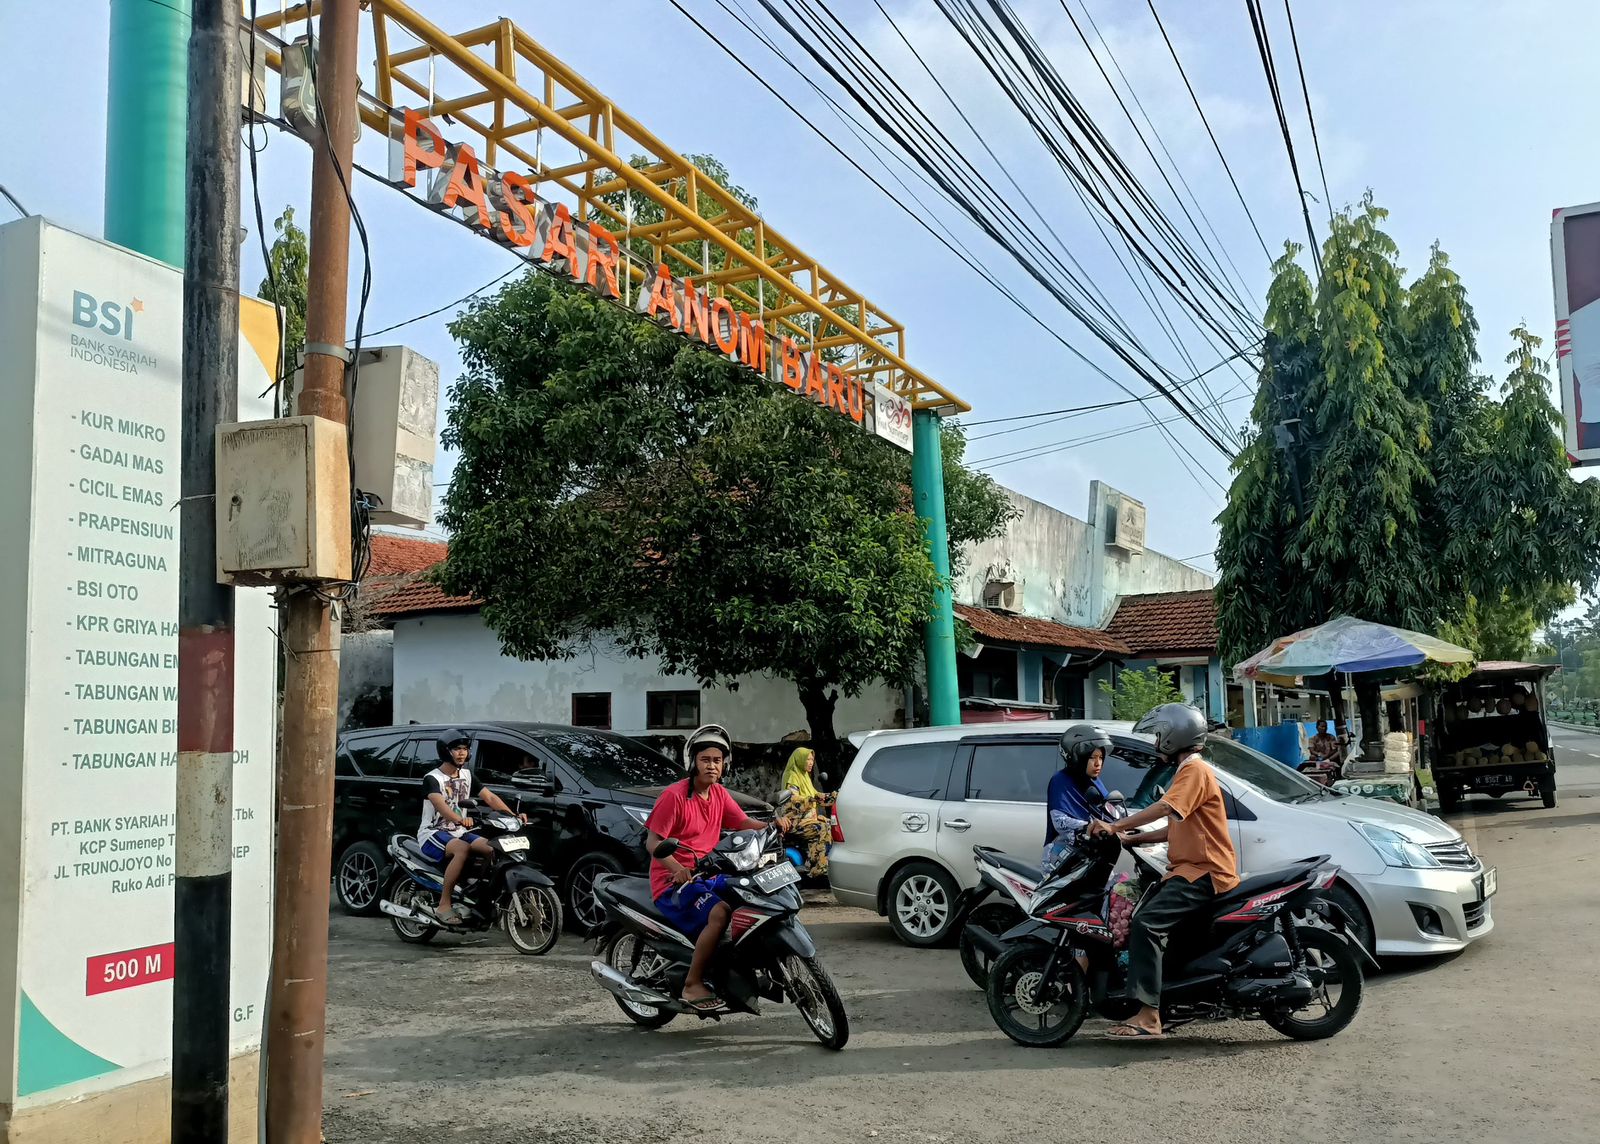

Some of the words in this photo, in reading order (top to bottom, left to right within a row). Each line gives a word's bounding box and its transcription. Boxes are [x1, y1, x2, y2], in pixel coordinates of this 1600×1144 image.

[402, 108, 620, 299] PASAR
[649, 264, 767, 374] ANOM
[781, 335, 864, 423] BARU
[72, 289, 133, 341] BSI
[70, 347, 138, 375] INDONESIA
[71, 334, 106, 354] BANK
[108, 345, 157, 369] SYARIAH
[81, 410, 114, 432] KUR
[118, 419, 165, 442] MIKRO
[80, 444, 128, 468] GADAI
[132, 454, 164, 475] MAS
[79, 478, 118, 499] CICIL
[122, 485, 163, 507] EMAS
[78, 511, 174, 541] PRAPENSIUN
[77, 546, 167, 572] MITRAGUNA
[77, 580, 102, 598] BSI
[107, 583, 138, 601] OTO
[76, 614, 109, 633] KPR
[113, 618, 157, 636] GRIYA
[75, 649, 160, 669] TABUNGAN
[74, 683, 159, 703] TABUNGAN
[73, 718, 158, 735] TABUNGAN
[72, 752, 157, 770] TABUNGAN
[51, 821, 70, 836] PT.
[74, 818, 112, 834] BANK
[115, 814, 169, 831] SYARIAH
[79, 840, 107, 856] KCP
[110, 836, 165, 852] Sumenep
[53, 865, 70, 880] JL
[73, 856, 153, 877] TRUNOJOYO
[156, 854, 172, 868] No
[111, 878, 143, 894] Ruko
[145, 874, 165, 889] Adi
[694, 892, 713, 911] FILA
[103, 960, 139, 983] 500
[145, 953, 162, 975] M
[233, 1004, 254, 1022] G.F
